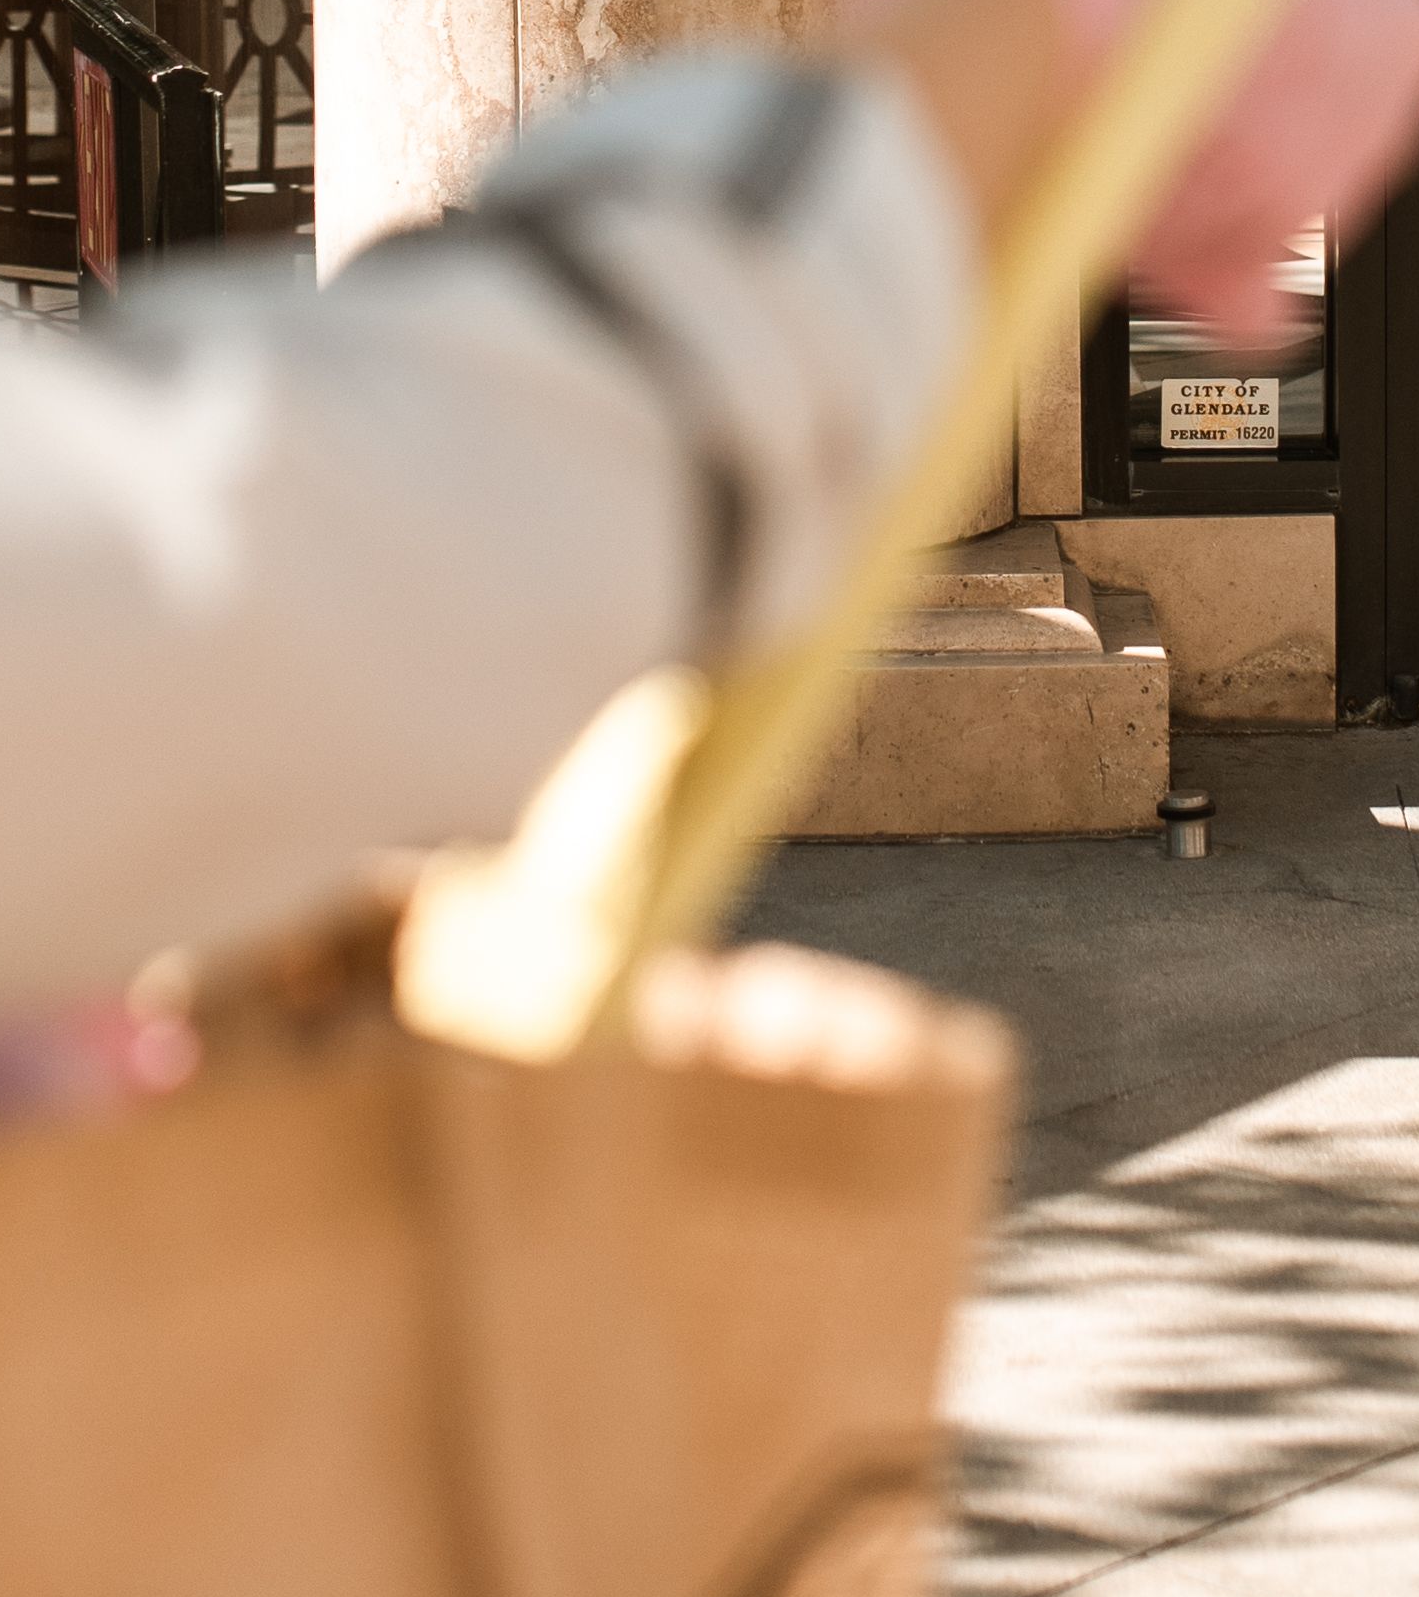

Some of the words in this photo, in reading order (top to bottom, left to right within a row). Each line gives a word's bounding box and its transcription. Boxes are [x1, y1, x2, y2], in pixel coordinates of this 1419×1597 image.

[1181, 386, 1225, 397] CITY
[1236, 385, 1259, 397] OF
[1171, 404, 1270, 415] GLENDALE
[1170, 430, 1227, 439] PERMIT
[1236, 427, 1275, 439] 16220
